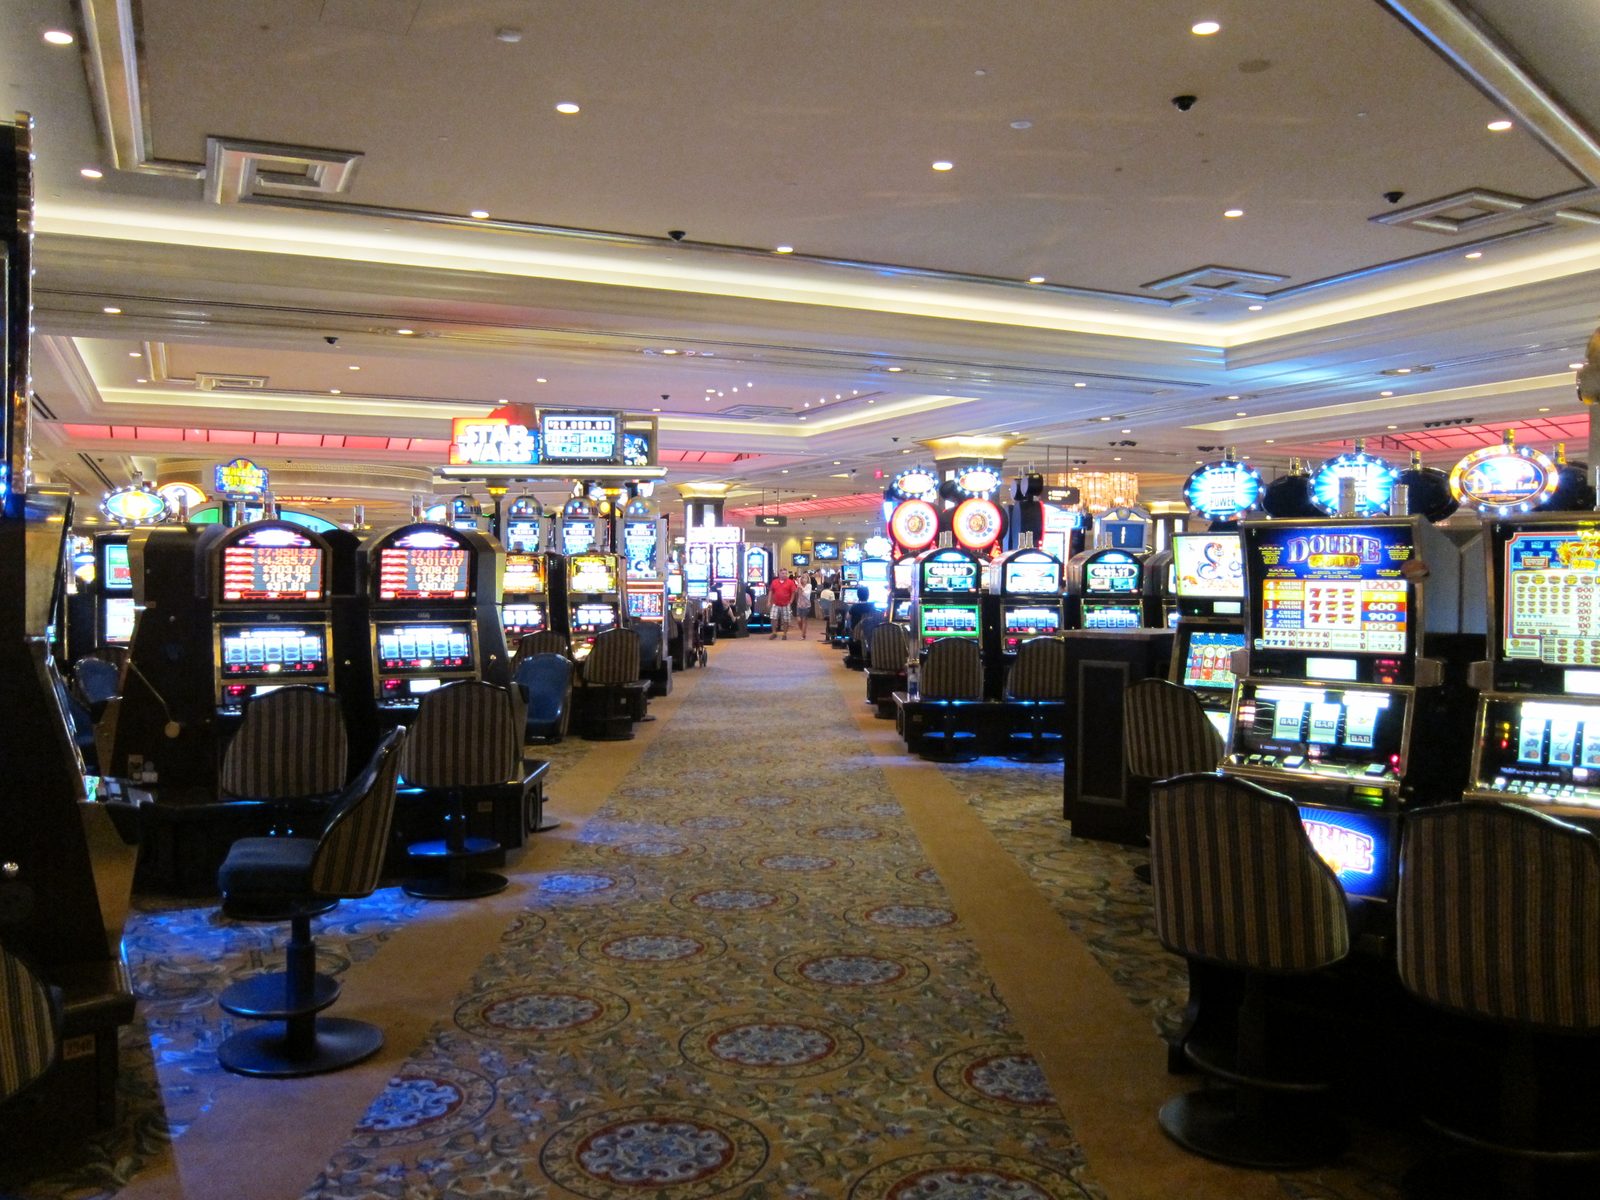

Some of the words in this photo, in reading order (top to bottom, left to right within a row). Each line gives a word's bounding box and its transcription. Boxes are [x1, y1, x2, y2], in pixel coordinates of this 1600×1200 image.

[458, 424, 534, 444] STAR
[458, 443, 533, 463] WARS
[1210, 496, 1236, 507] POWER
[1287, 534, 1382, 564] DOUBLE
[1368, 602, 1397, 611] 600
[1368, 612, 1397, 621] 900
[1280, 718, 1298, 726] BAR
[1315, 721, 1334, 729] BAR
[1351, 736, 1370, 744] BAR
